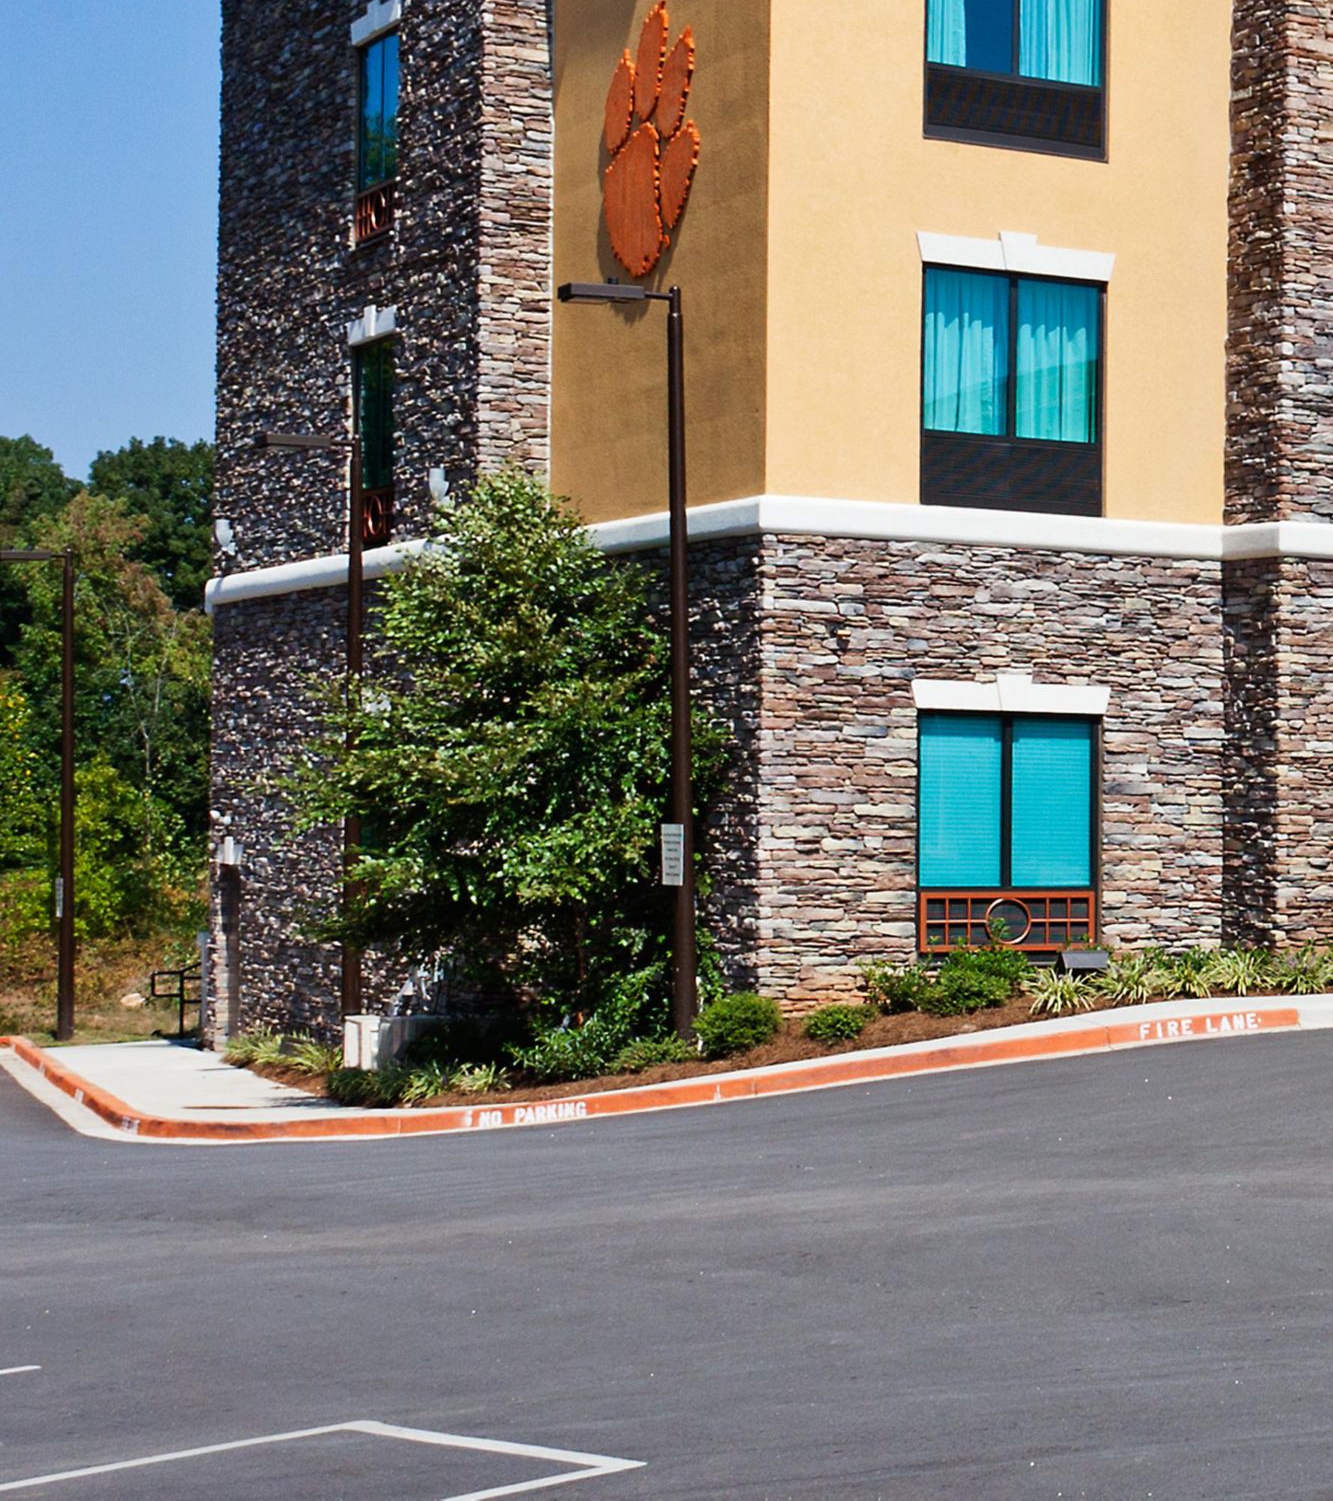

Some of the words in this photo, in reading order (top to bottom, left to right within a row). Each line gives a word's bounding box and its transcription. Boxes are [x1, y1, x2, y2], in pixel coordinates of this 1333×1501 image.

[1139, 1019, 1193, 1040] FIRE
[1206, 1012, 1259, 1034] LANE
[479, 1110, 502, 1128] NO
[514, 1101, 587, 1125] PARKING
